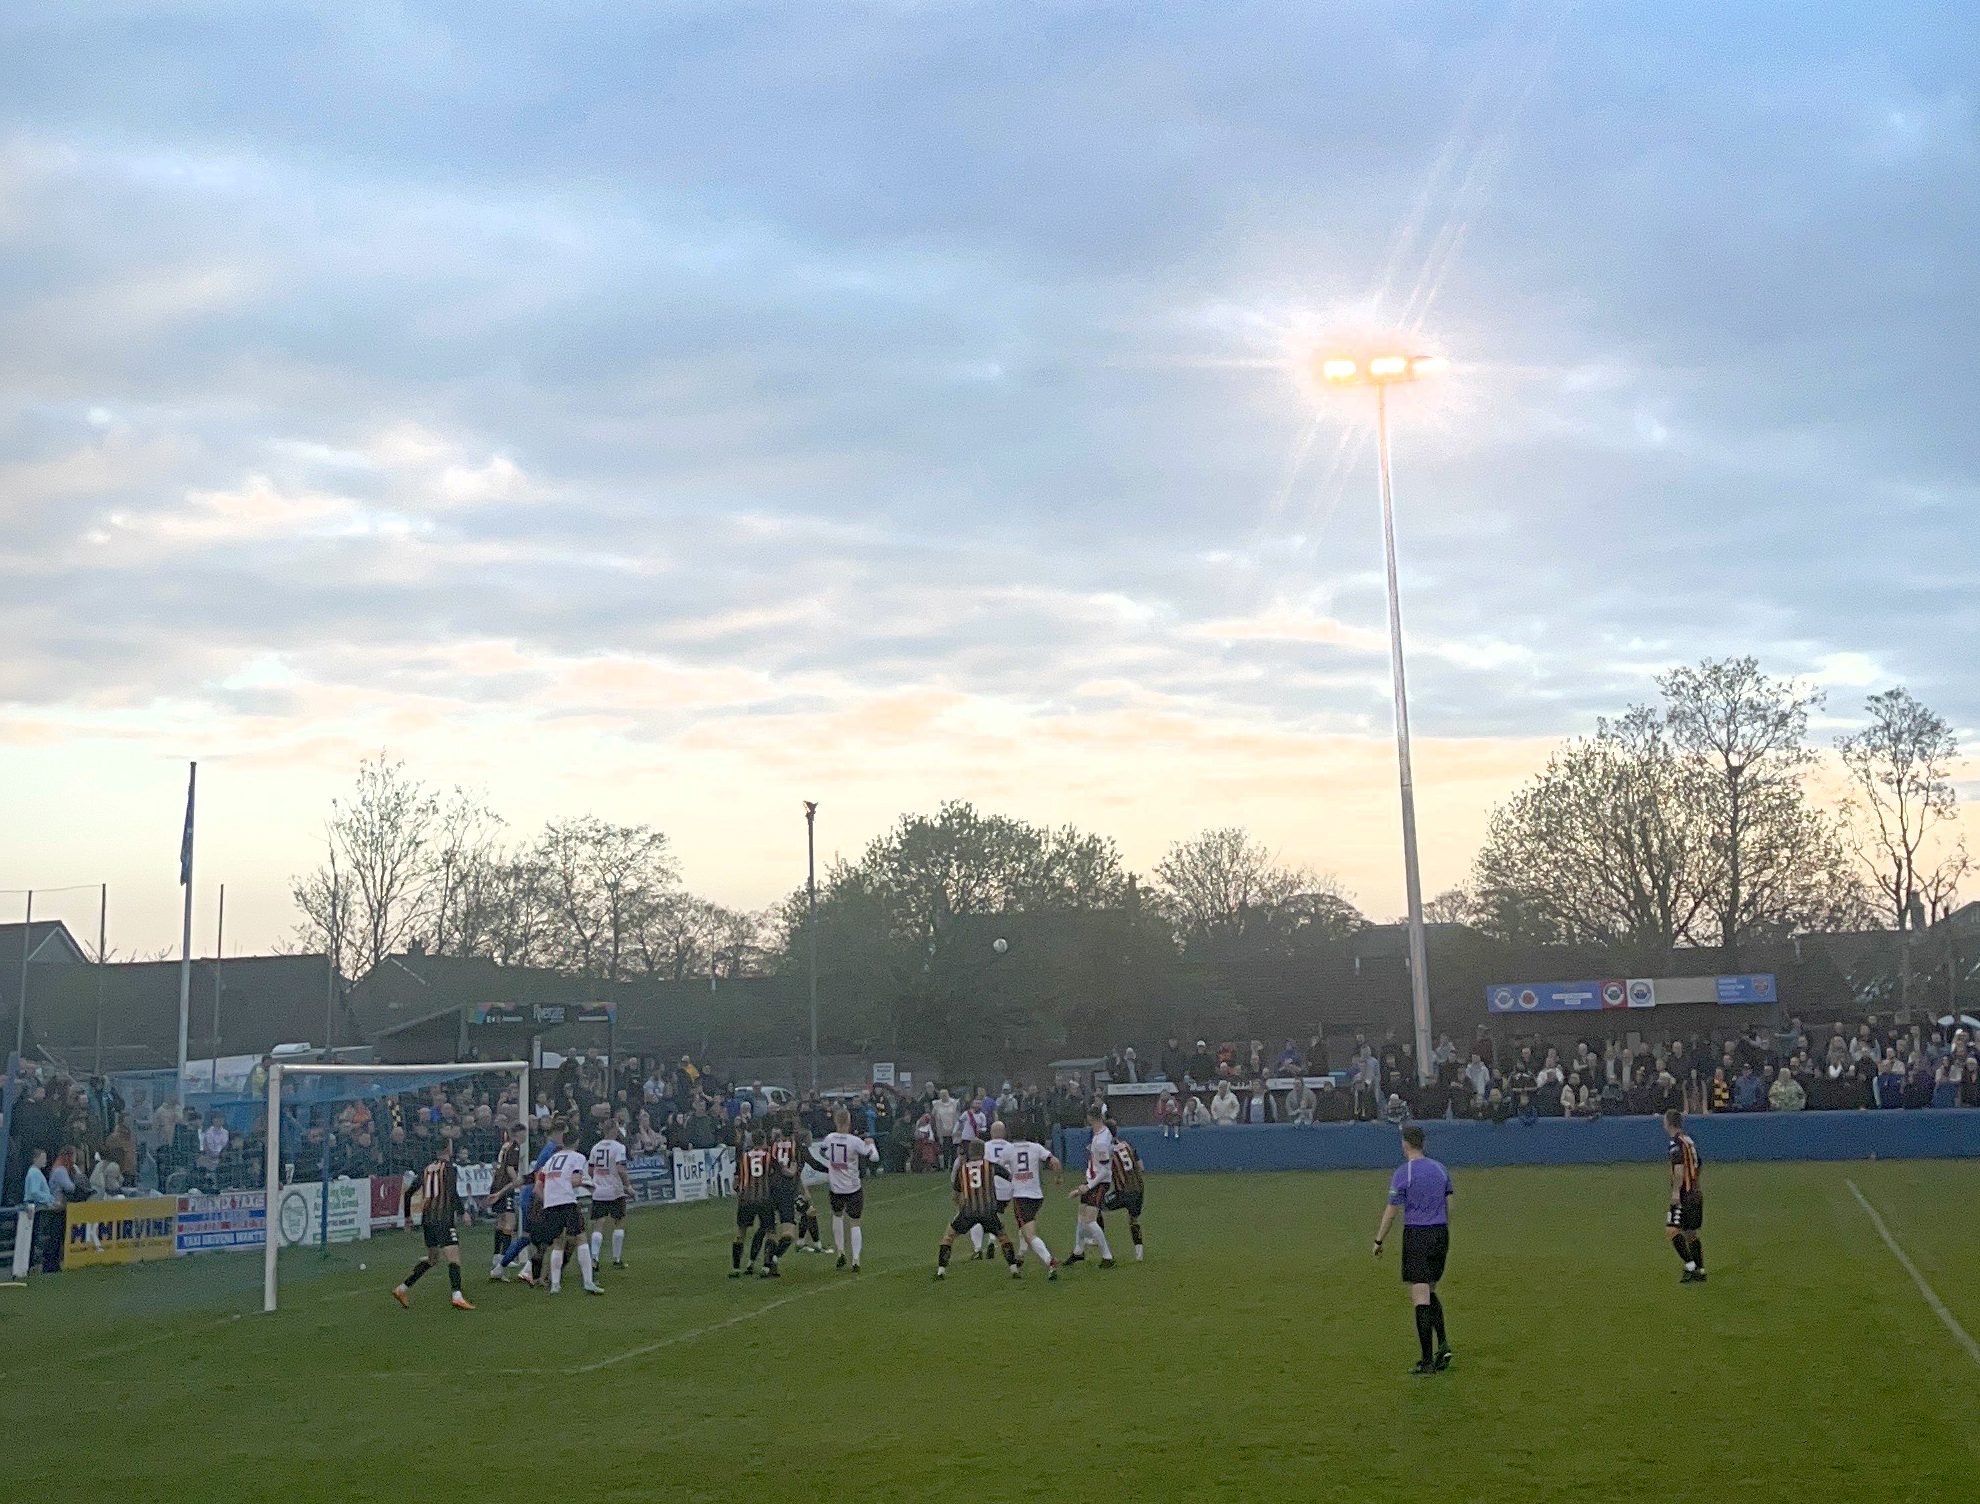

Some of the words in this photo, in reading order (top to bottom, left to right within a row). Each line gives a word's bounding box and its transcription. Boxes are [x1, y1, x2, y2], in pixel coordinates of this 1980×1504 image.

[596, 1149, 609, 1168] 21
[777, 1147, 791, 1167] 4
[830, 1142, 848, 1162] 17
[1017, 1151, 1029, 1172] 9
[1119, 1150, 1133, 1172] 5
[549, 1155, 568, 1171] 10
[676, 1161, 704, 1181] TURF
[749, 1158, 764, 1178] 6
[425, 1171, 439, 1197] 11
[968, 1167, 982, 1188] 3
[70, 1221, 113, 1251] MKM
[116, 1216, 173, 1240] IRVINE
